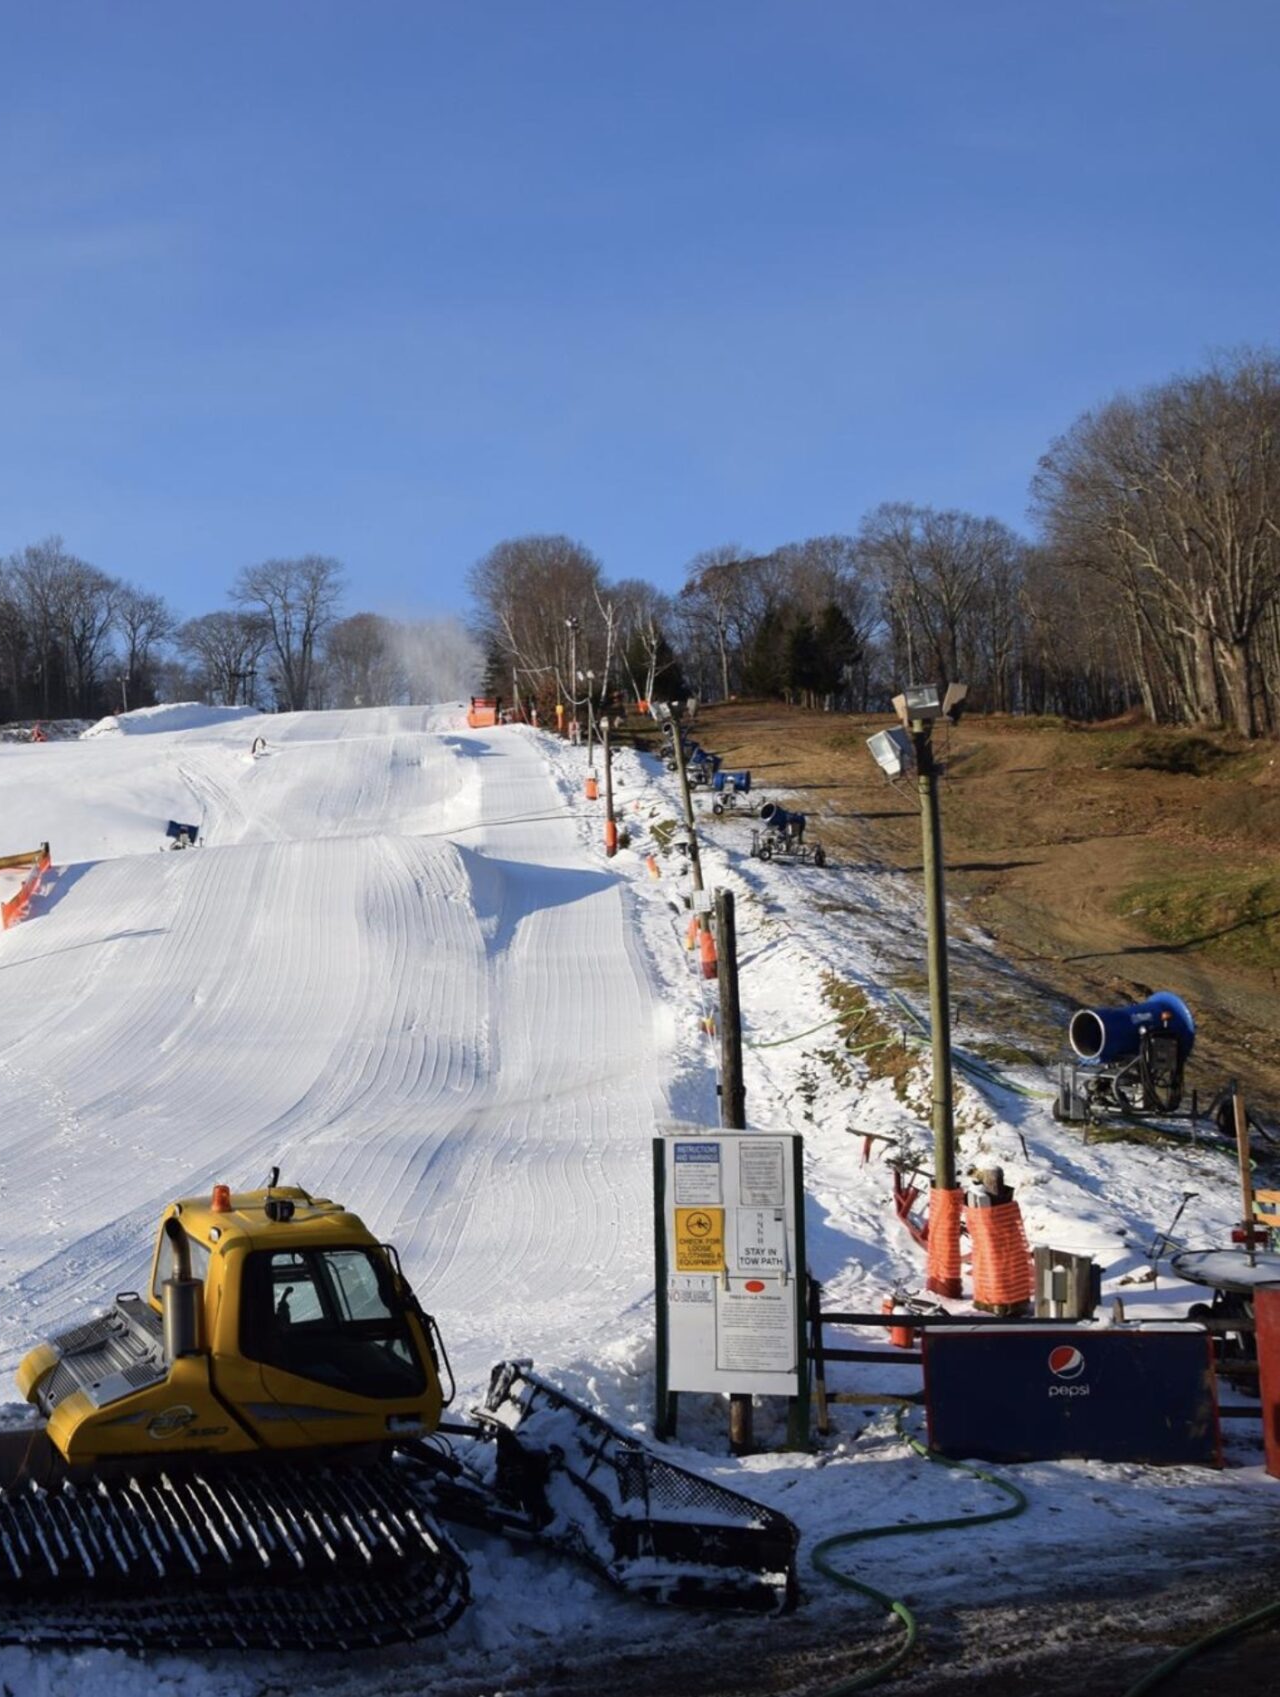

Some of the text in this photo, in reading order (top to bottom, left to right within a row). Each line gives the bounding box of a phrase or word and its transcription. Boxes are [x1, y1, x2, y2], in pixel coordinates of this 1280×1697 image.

[740, 1257, 783, 1265] TOW PATH
[1048, 1384, 1090, 1398] pepsi
